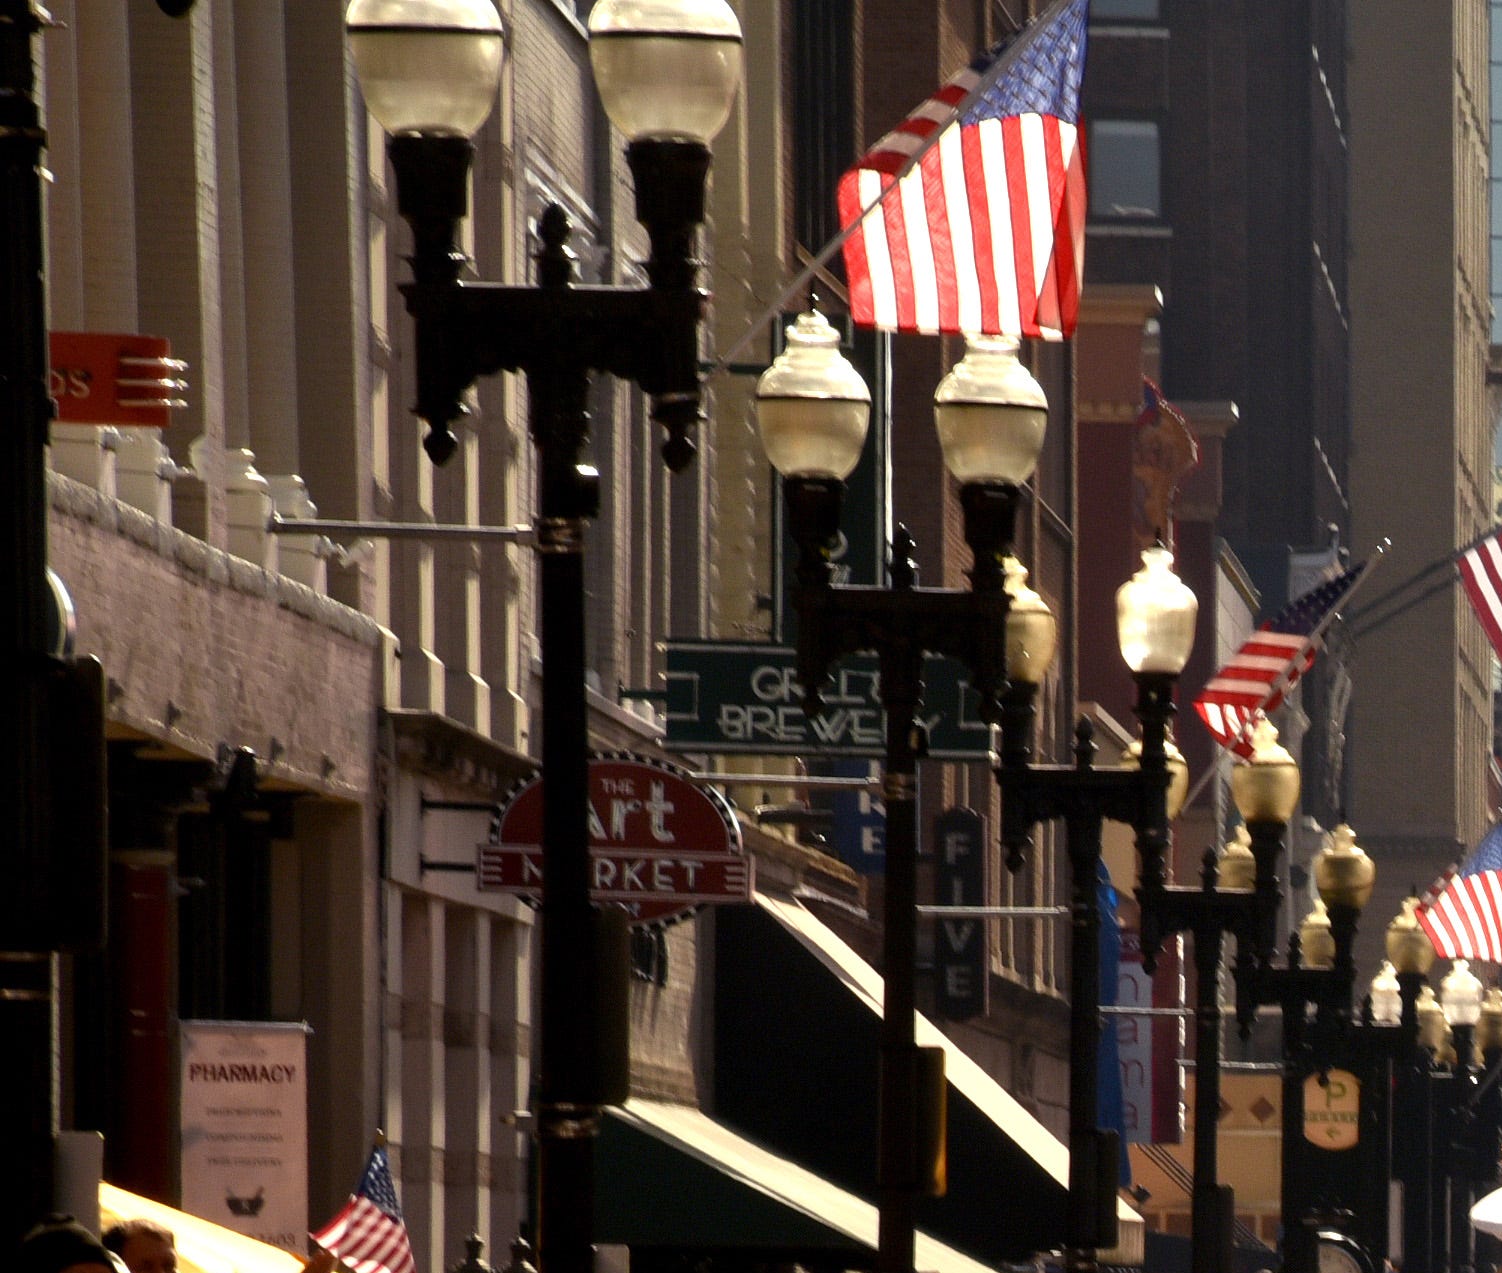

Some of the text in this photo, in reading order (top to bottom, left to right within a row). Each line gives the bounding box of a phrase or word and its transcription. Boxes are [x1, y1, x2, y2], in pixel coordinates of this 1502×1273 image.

[717, 704, 941, 744] BREWEY
[600, 777, 635, 796] THE
[521, 852, 704, 893] MRKET
[189, 1062, 296, 1083] PHARMACY
